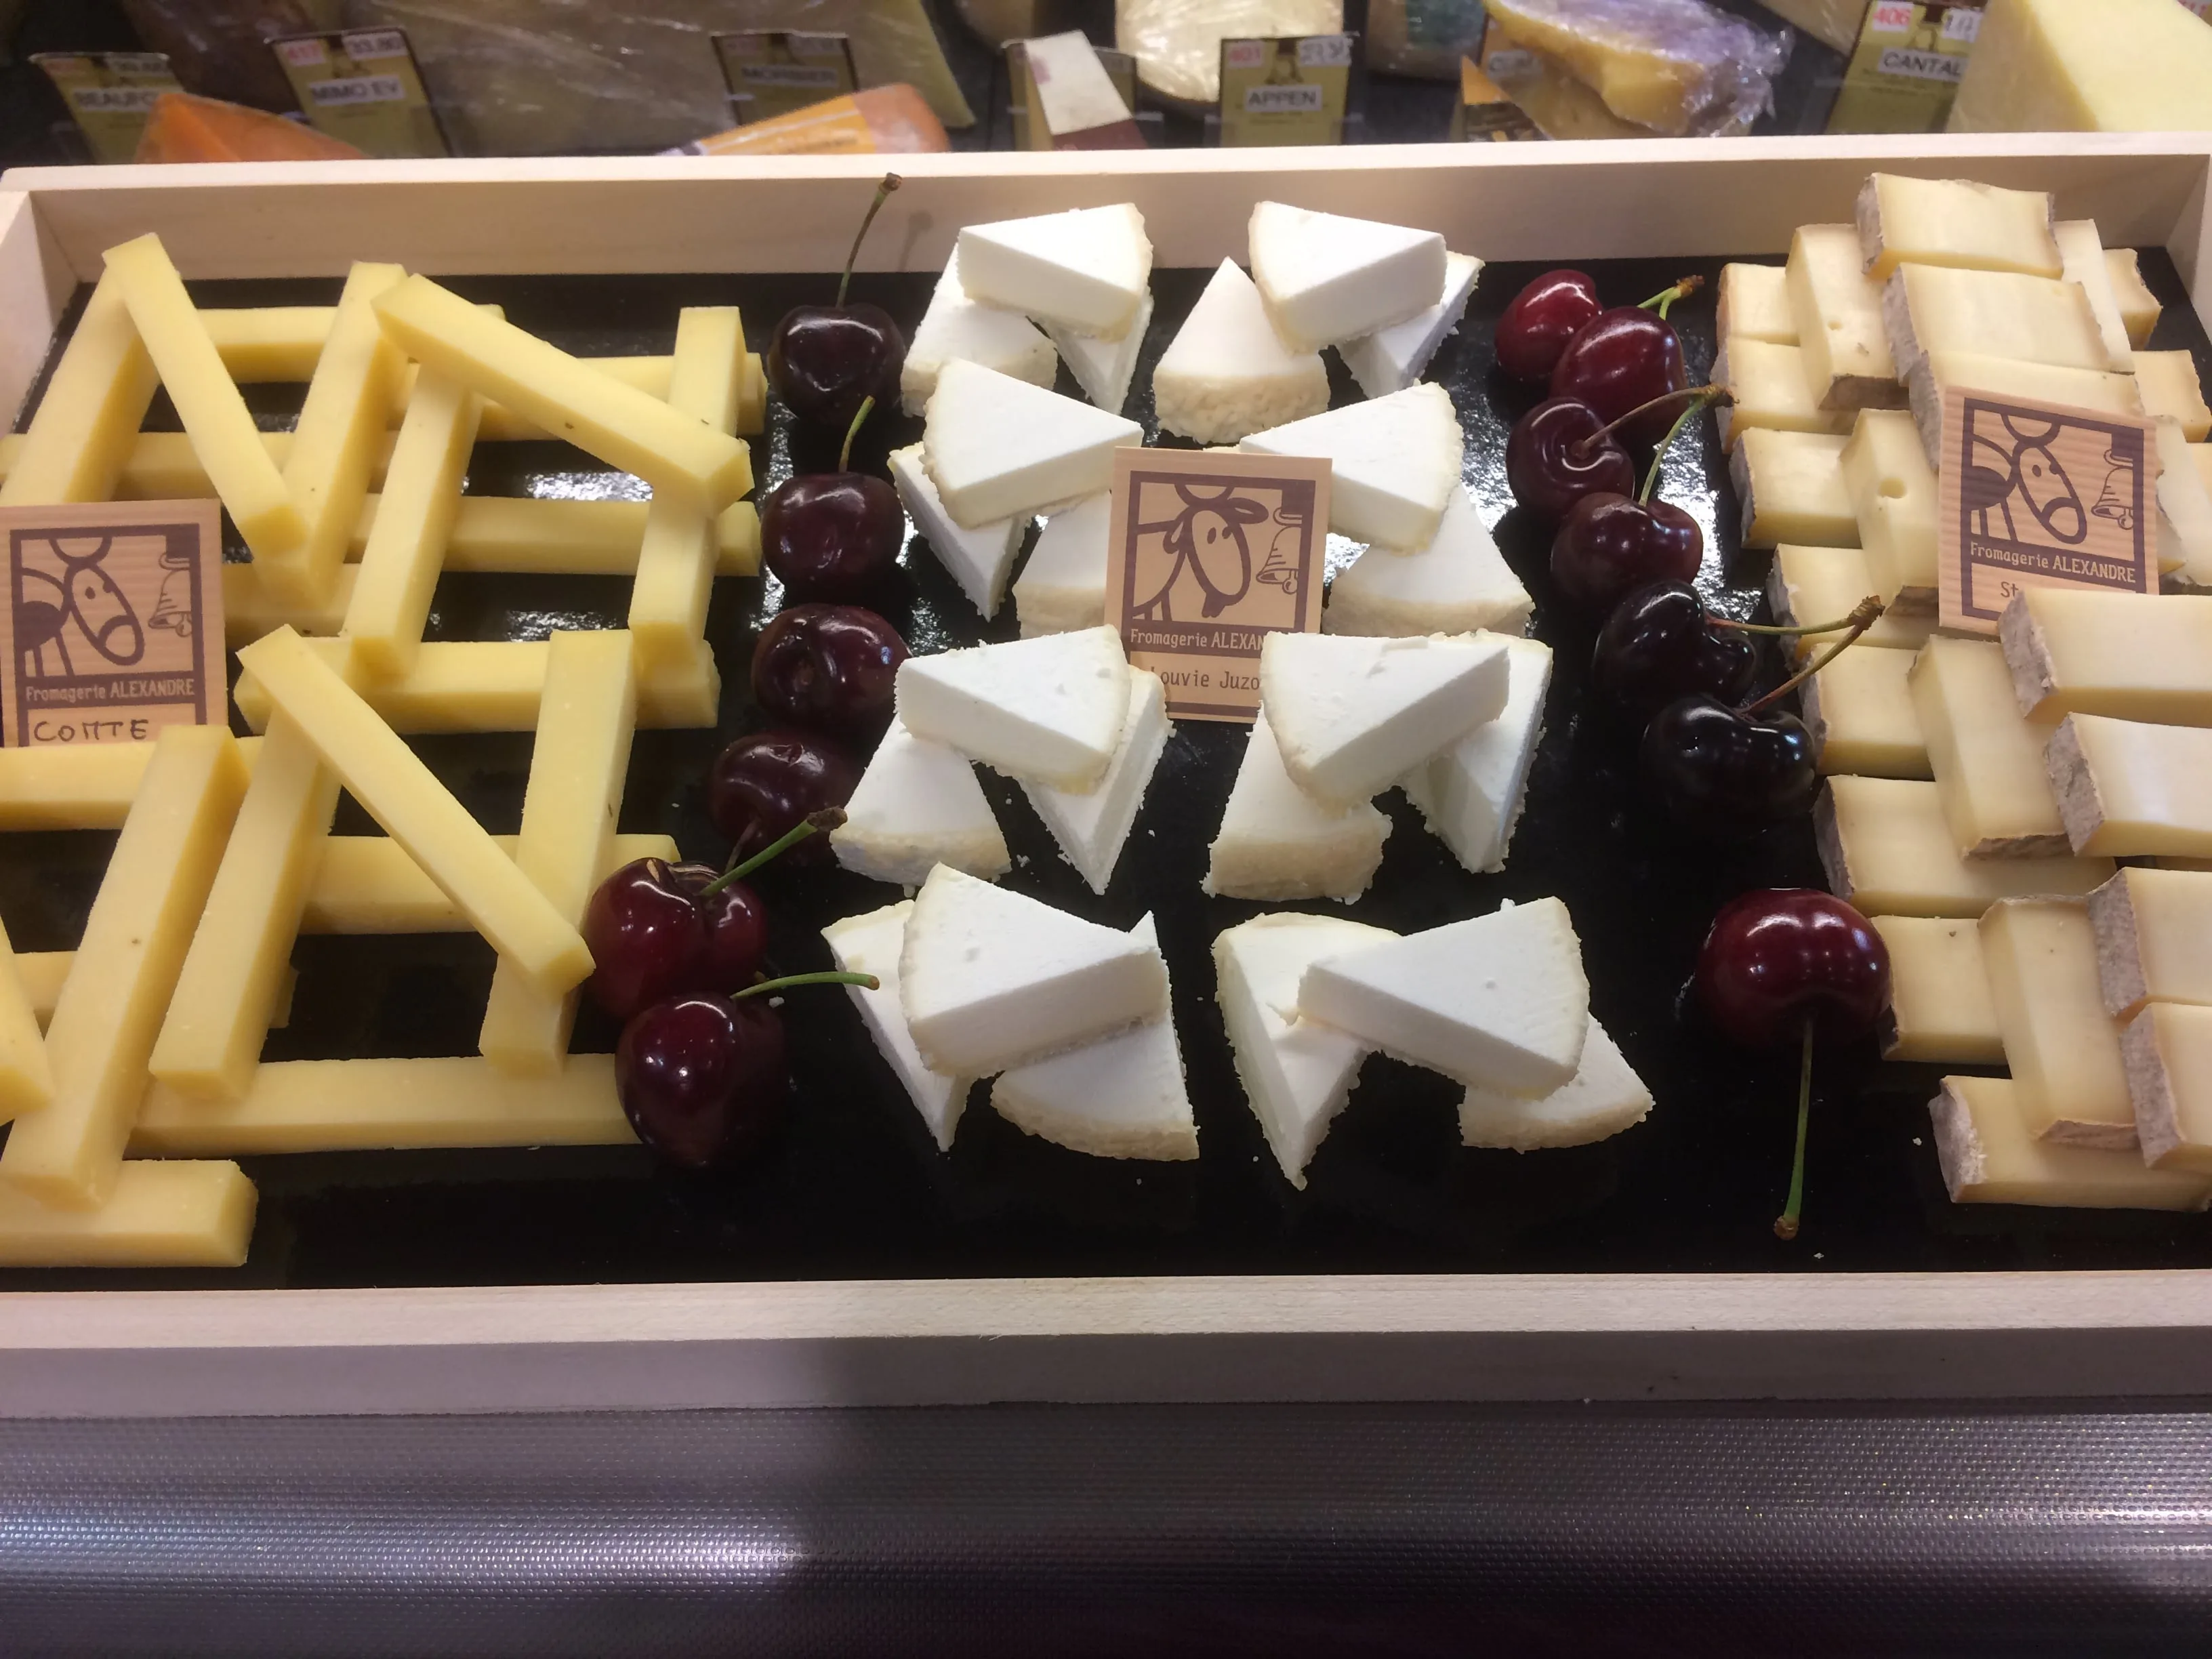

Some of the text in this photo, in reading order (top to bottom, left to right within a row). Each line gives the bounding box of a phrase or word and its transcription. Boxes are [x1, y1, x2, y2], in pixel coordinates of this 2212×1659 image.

[1883, 52, 1961, 77] CANTAL
[1971, 541, 2136, 583] Fromagerie ALEXANDRE
[1130, 628, 1207, 648] Fromagerie
[26, 678, 195, 703] Fromagerie ALEXANDRE
[1151, 666, 1260, 690] ouvie Juzo
